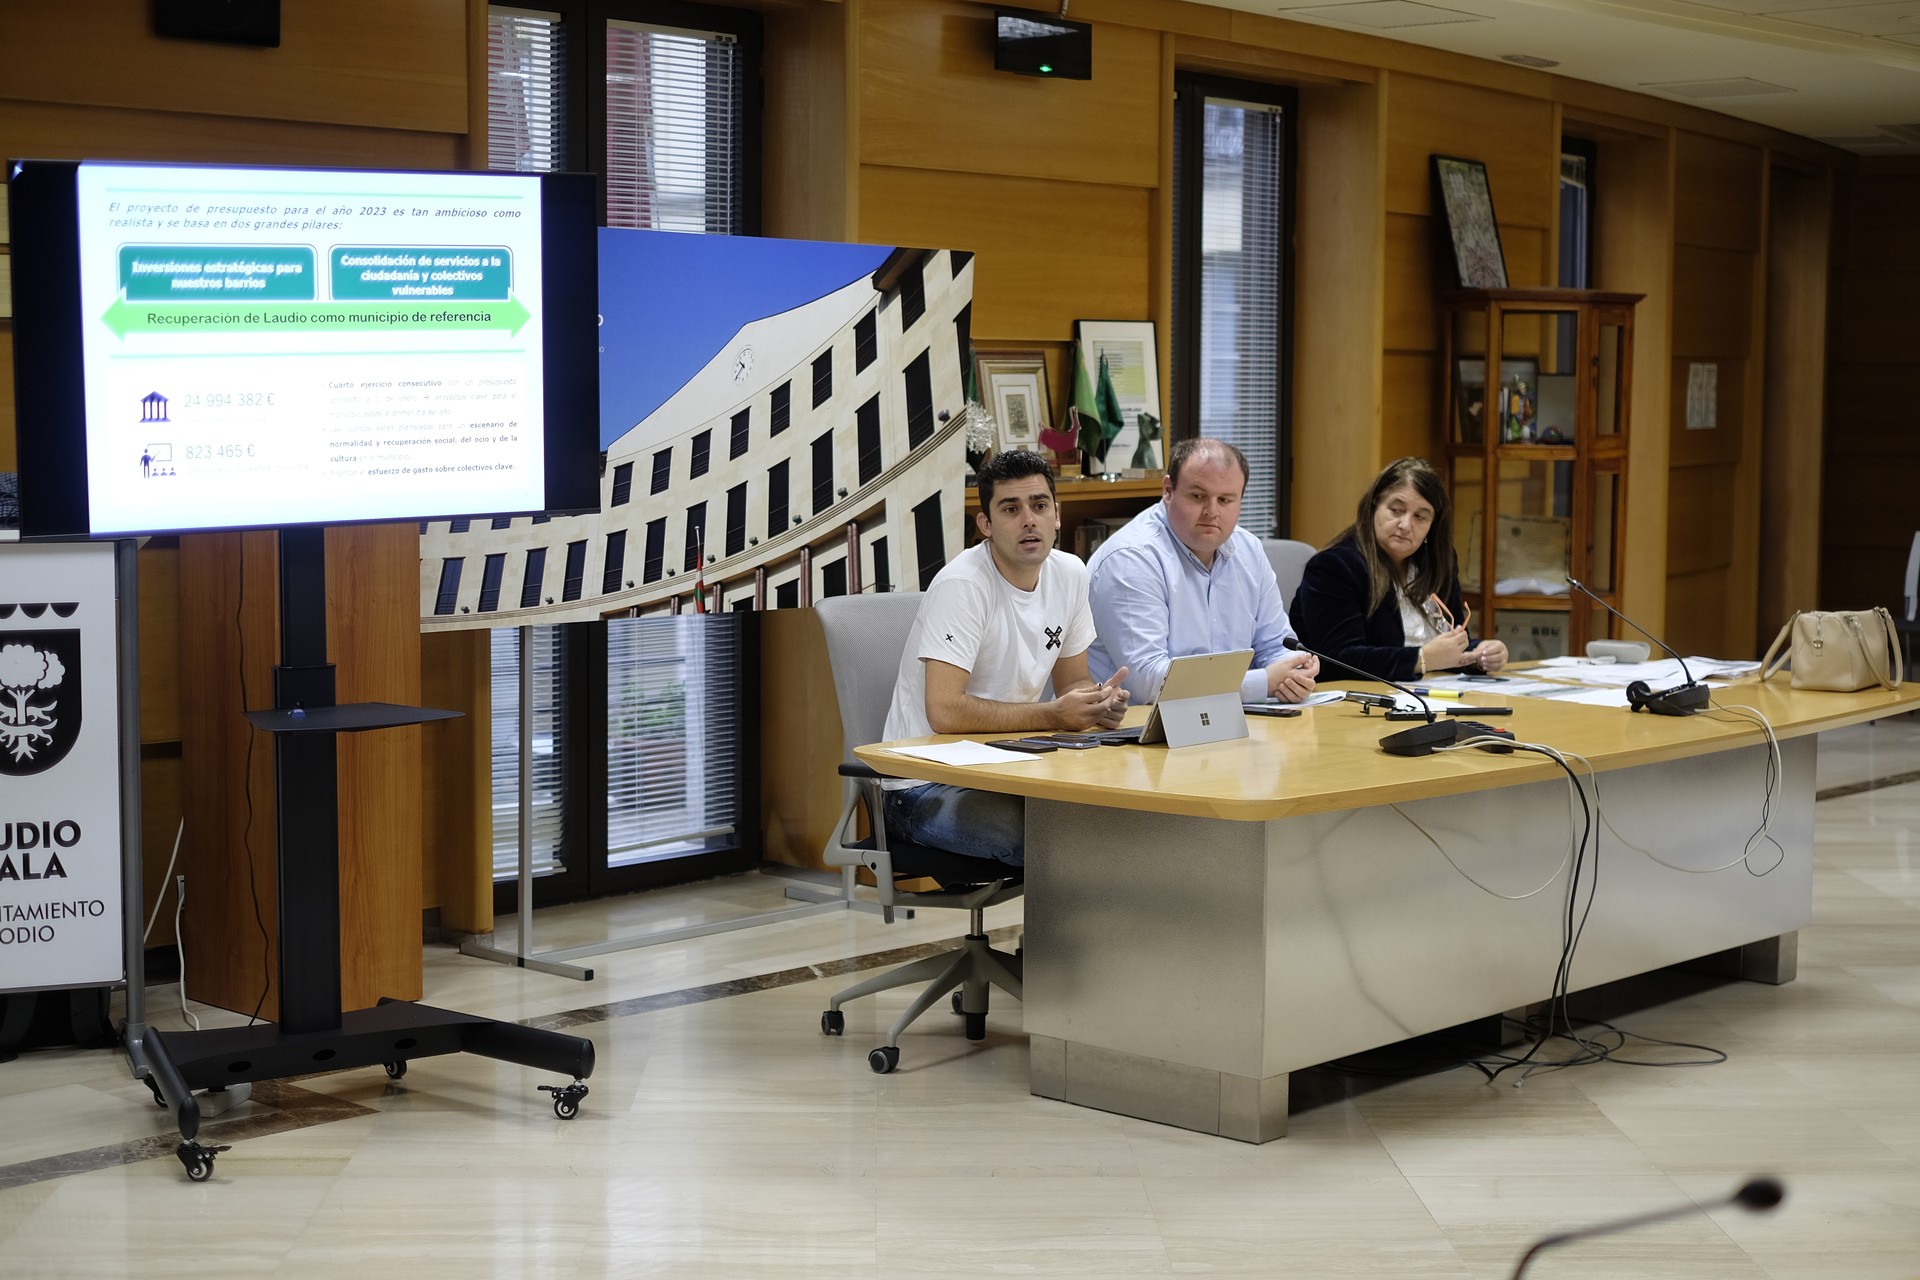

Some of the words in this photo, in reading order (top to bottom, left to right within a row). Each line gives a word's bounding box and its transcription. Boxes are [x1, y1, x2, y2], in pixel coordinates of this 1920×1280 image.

[109, 202, 120, 212] El
[127, 203, 178, 217] proyecto
[186, 204, 200, 213] de
[206, 205, 277, 218] presupuesto
[283, 207, 308, 217] para
[316, 206, 326, 215] el
[332, 205, 352, 216] año
[359, 207, 387, 216] 2023
[393, 208, 405, 217] es
[411, 207, 428, 217] tan
[435, 208, 487, 218] ambicioso
[493, 210, 521, 218] como
[109, 217, 153, 228] realista
[157, 220, 164, 230] y
[167, 220, 180, 228] se
[183, 218, 209, 228] basa
[213, 220, 227, 228] en
[230, 219, 251, 229] dos
[253, 219, 299, 231] grandes
[301, 220, 343, 231] pilares:
[341, 255, 416, 267] Consolidación
[418, 256, 432, 267] de
[434, 256, 480, 267] servicios
[482, 258, 489, 267] a
[491, 256, 502, 267] la
[131, 261, 203, 274] Inversiones
[204, 261, 274, 276] estratégicas
[276, 263, 303, 276] para
[171, 278, 223, 289] nuestros
[225, 277, 267, 289] barrios
[360, 270, 419, 281] ciudadanía
[421, 272, 430, 283] y
[431, 270, 483, 281] colectivos
[392, 285, 454, 296] vulnerables
[147, 312, 240, 326] Recuperación
[244, 312, 260, 323] de
[263, 312, 307, 323] Laudio
[310, 314, 345, 323] como
[349, 311, 408, 325] municipio
[412, 311, 427, 323] de
[430, 310, 491, 322] referencia
[328, 381, 354, 389] Cuarto
[360, 380, 393, 390] ejercicio
[398, 379, 442, 387] consecutivo
[469, 421, 505, 429] escenario
[509, 420, 518, 428] de
[329, 439, 373, 448] normalidad
[383, 437, 432, 447] recuperación
[434, 436, 457, 445] social,
[474, 435, 489, 443] ocio
[499, 434, 509, 442] de
[511, 434, 518, 442] la
[329, 454, 357, 462] cultura
[367, 467, 400, 476] esfuerzo
[412, 466, 433, 475] gasto
[434, 465, 455, 473] sobre
[457, 464, 493, 472] colectivos
[494, 462, 516, 471] clave.
[0, 899, 105, 922] TAMIENTO
[0, 925, 54, 945] ODIO
